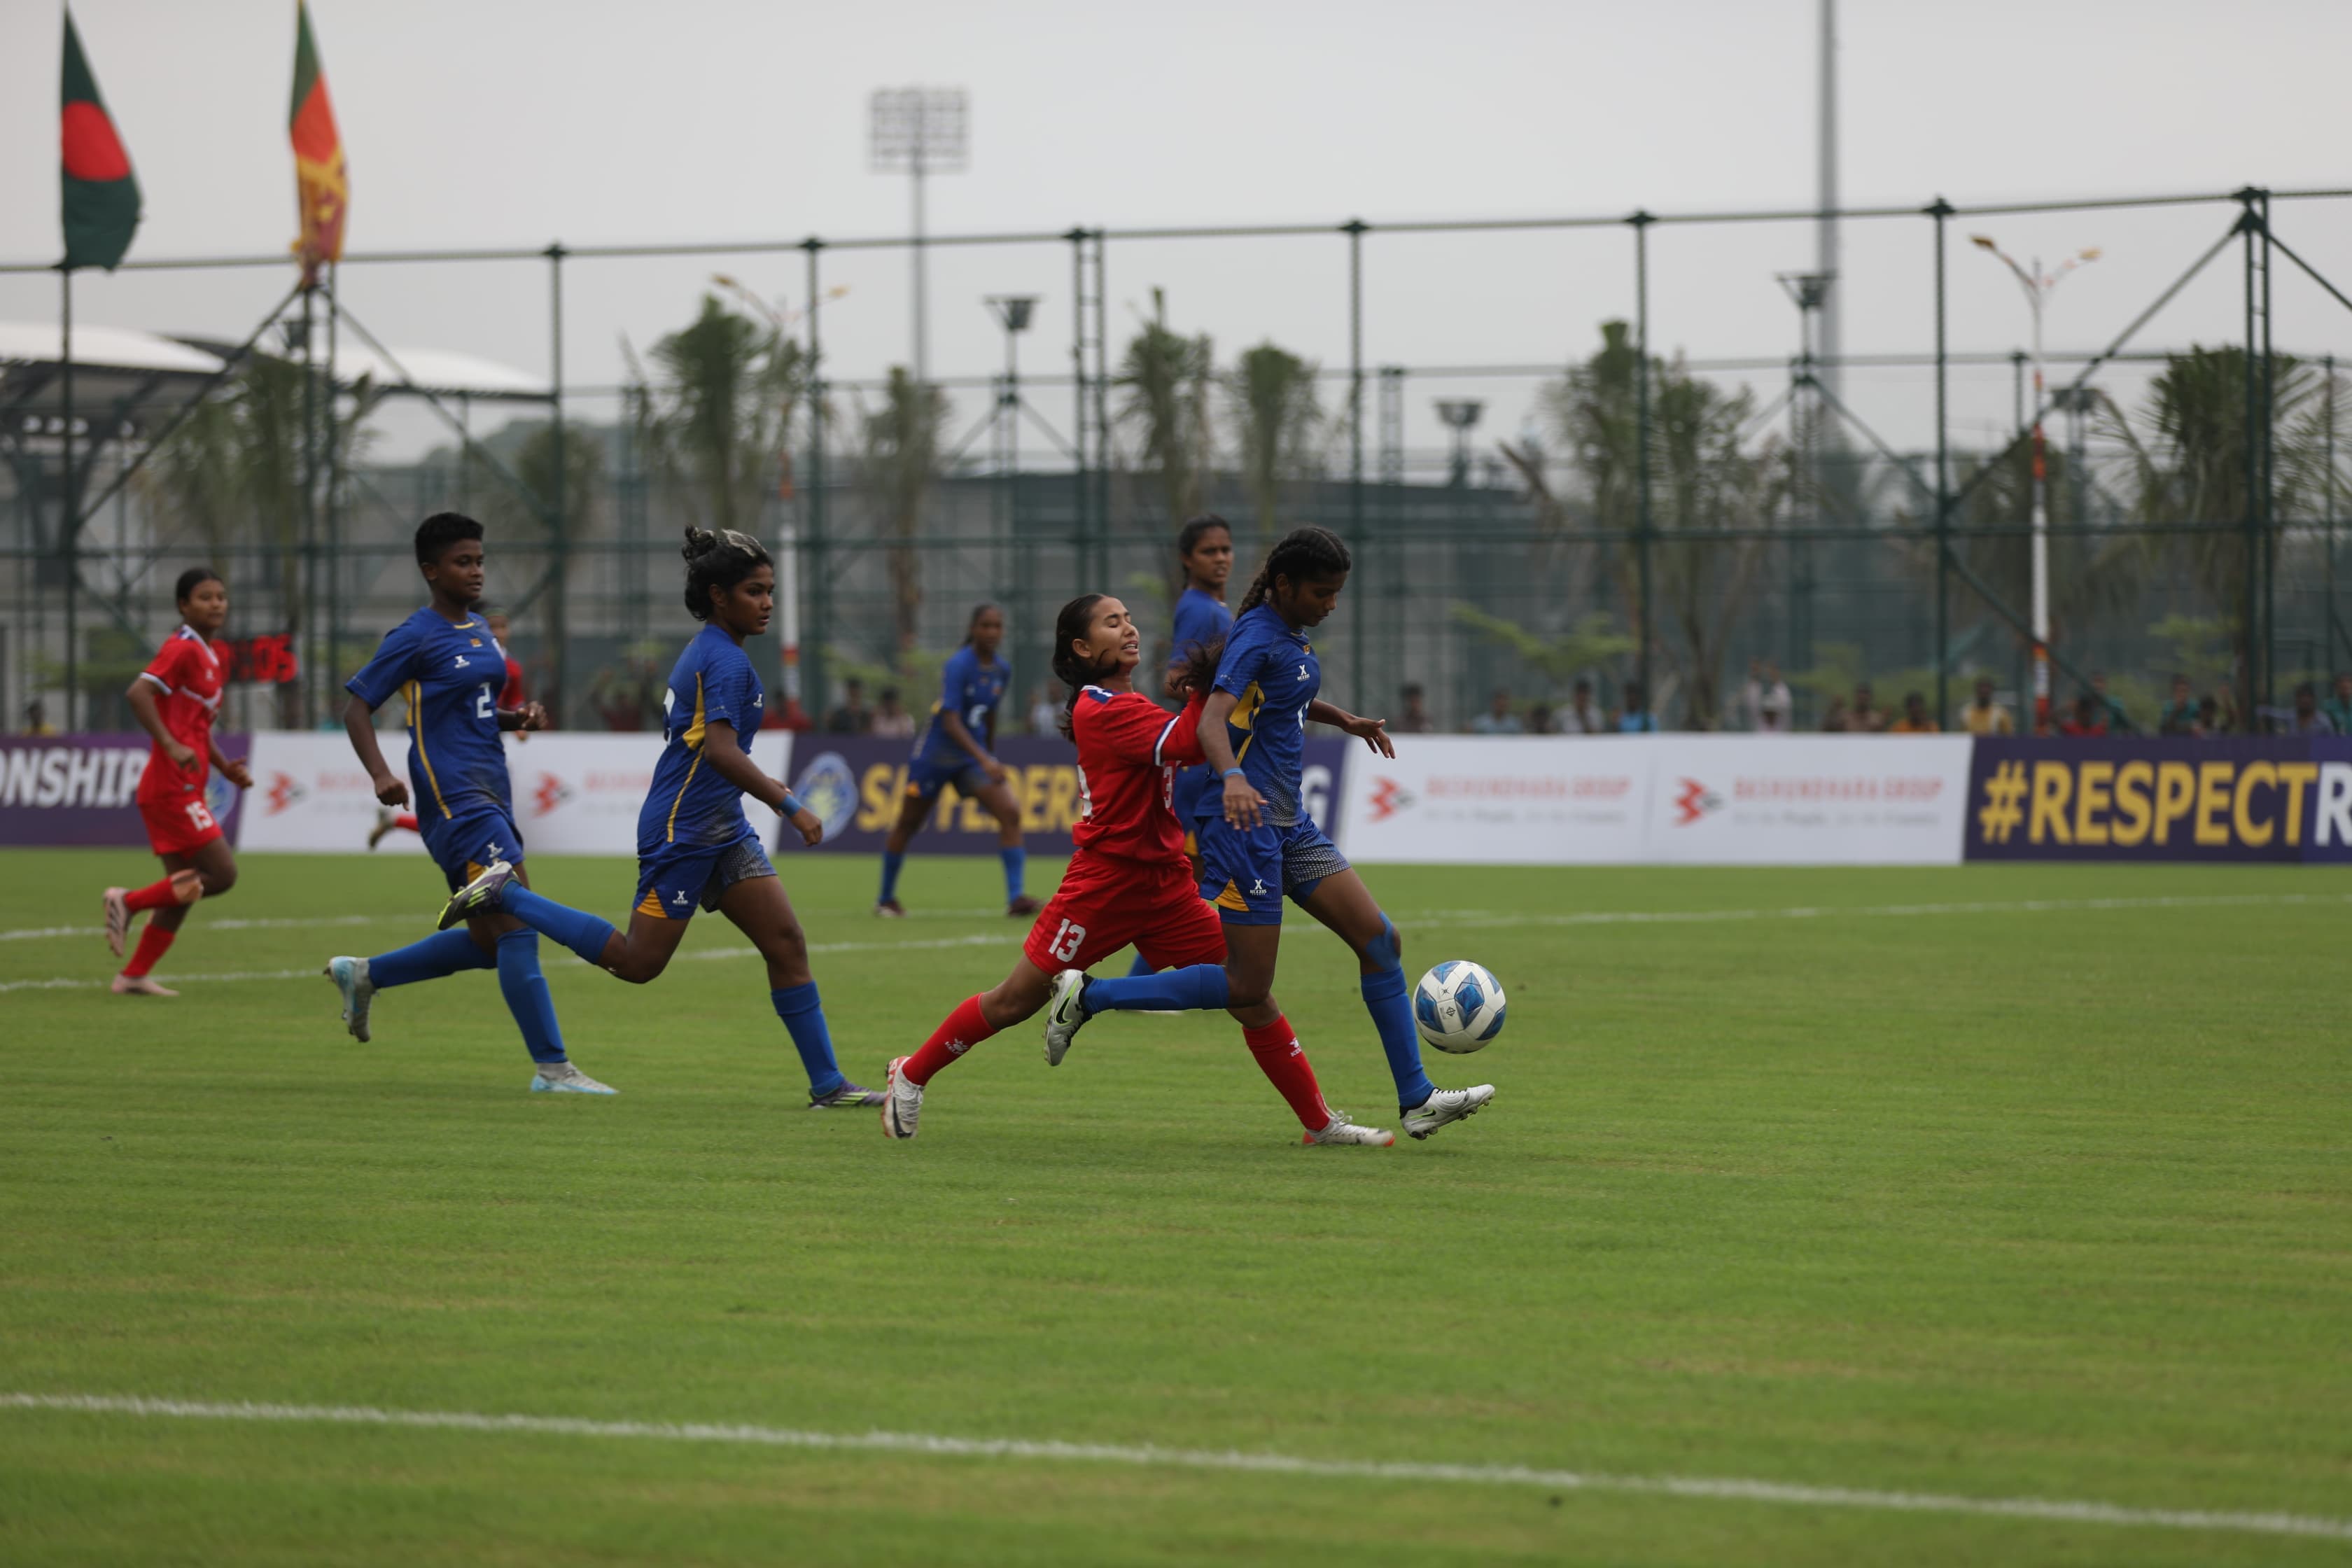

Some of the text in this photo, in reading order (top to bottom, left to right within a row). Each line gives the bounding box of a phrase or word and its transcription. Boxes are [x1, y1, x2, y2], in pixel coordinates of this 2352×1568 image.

[477, 682, 493, 719] 2
[0, 746, 151, 808] NSHIP
[1048, 918, 1086, 962] 13
